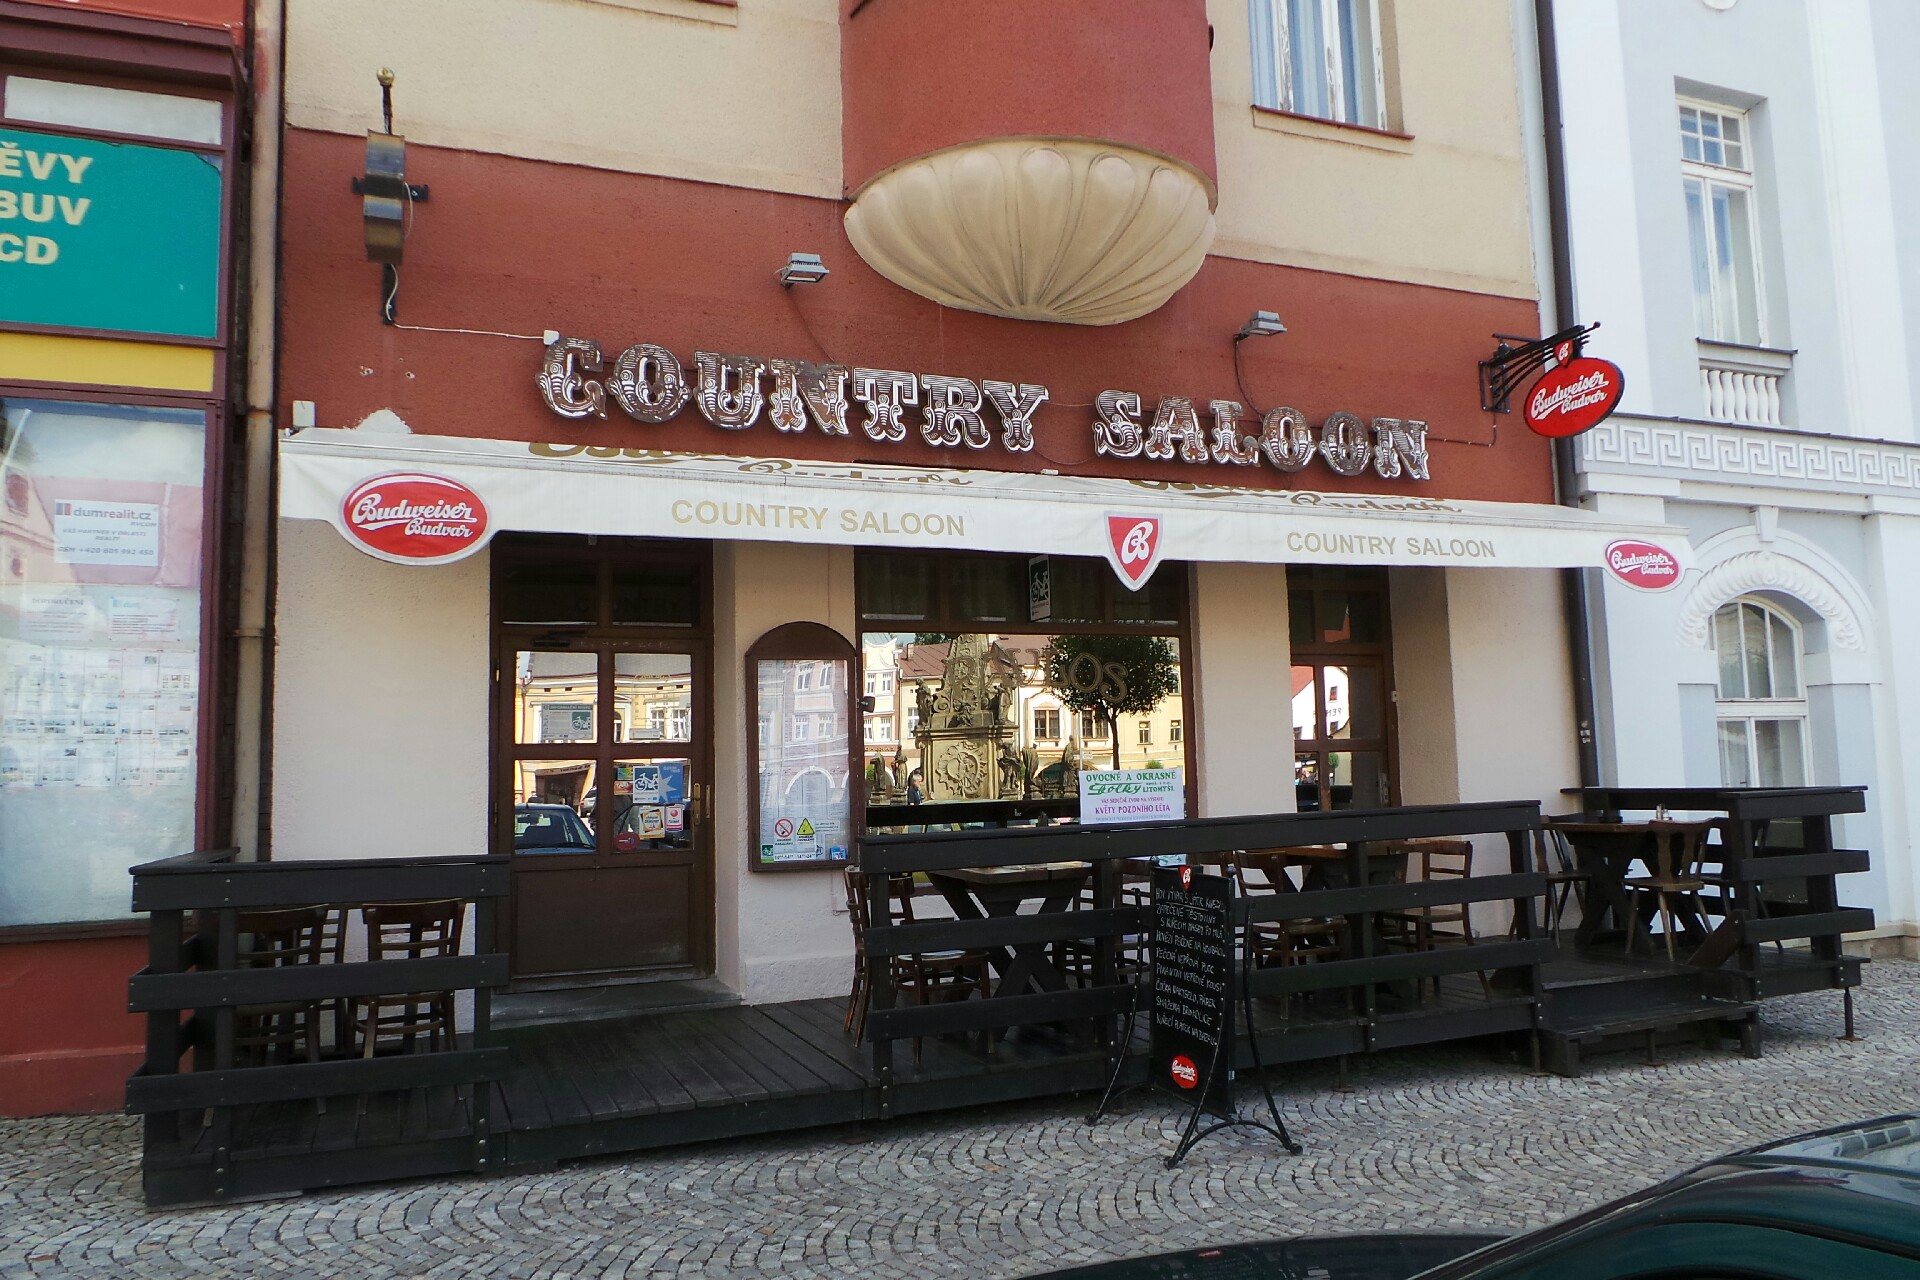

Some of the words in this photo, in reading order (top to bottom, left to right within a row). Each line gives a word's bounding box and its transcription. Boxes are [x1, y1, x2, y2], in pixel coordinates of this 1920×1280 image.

[1531, 371, 1609, 418] Budweiser
[1561, 390, 1607, 414] Budvar
[535, 337, 1049, 454] COUNTRY
[1094, 389, 1431, 481] SALOON
[73, 507, 152, 520] dumrealit.cz
[352, 493, 477, 523] Budweiser
[671, 499, 828, 531] COUNTRY
[839, 508, 965, 538] SALOON
[404, 517, 473, 538] Budvar
[1287, 531, 1397, 556] COUNTRY
[1407, 535, 1496, 559] SALOON
[1611, 551, 1673, 570] Budweiser
[1086, 771, 1121, 782] OVOCNÉ
[1136, 769, 1177, 781] OKRASNÉ
[1095, 804, 1116, 815] KVĚTY
